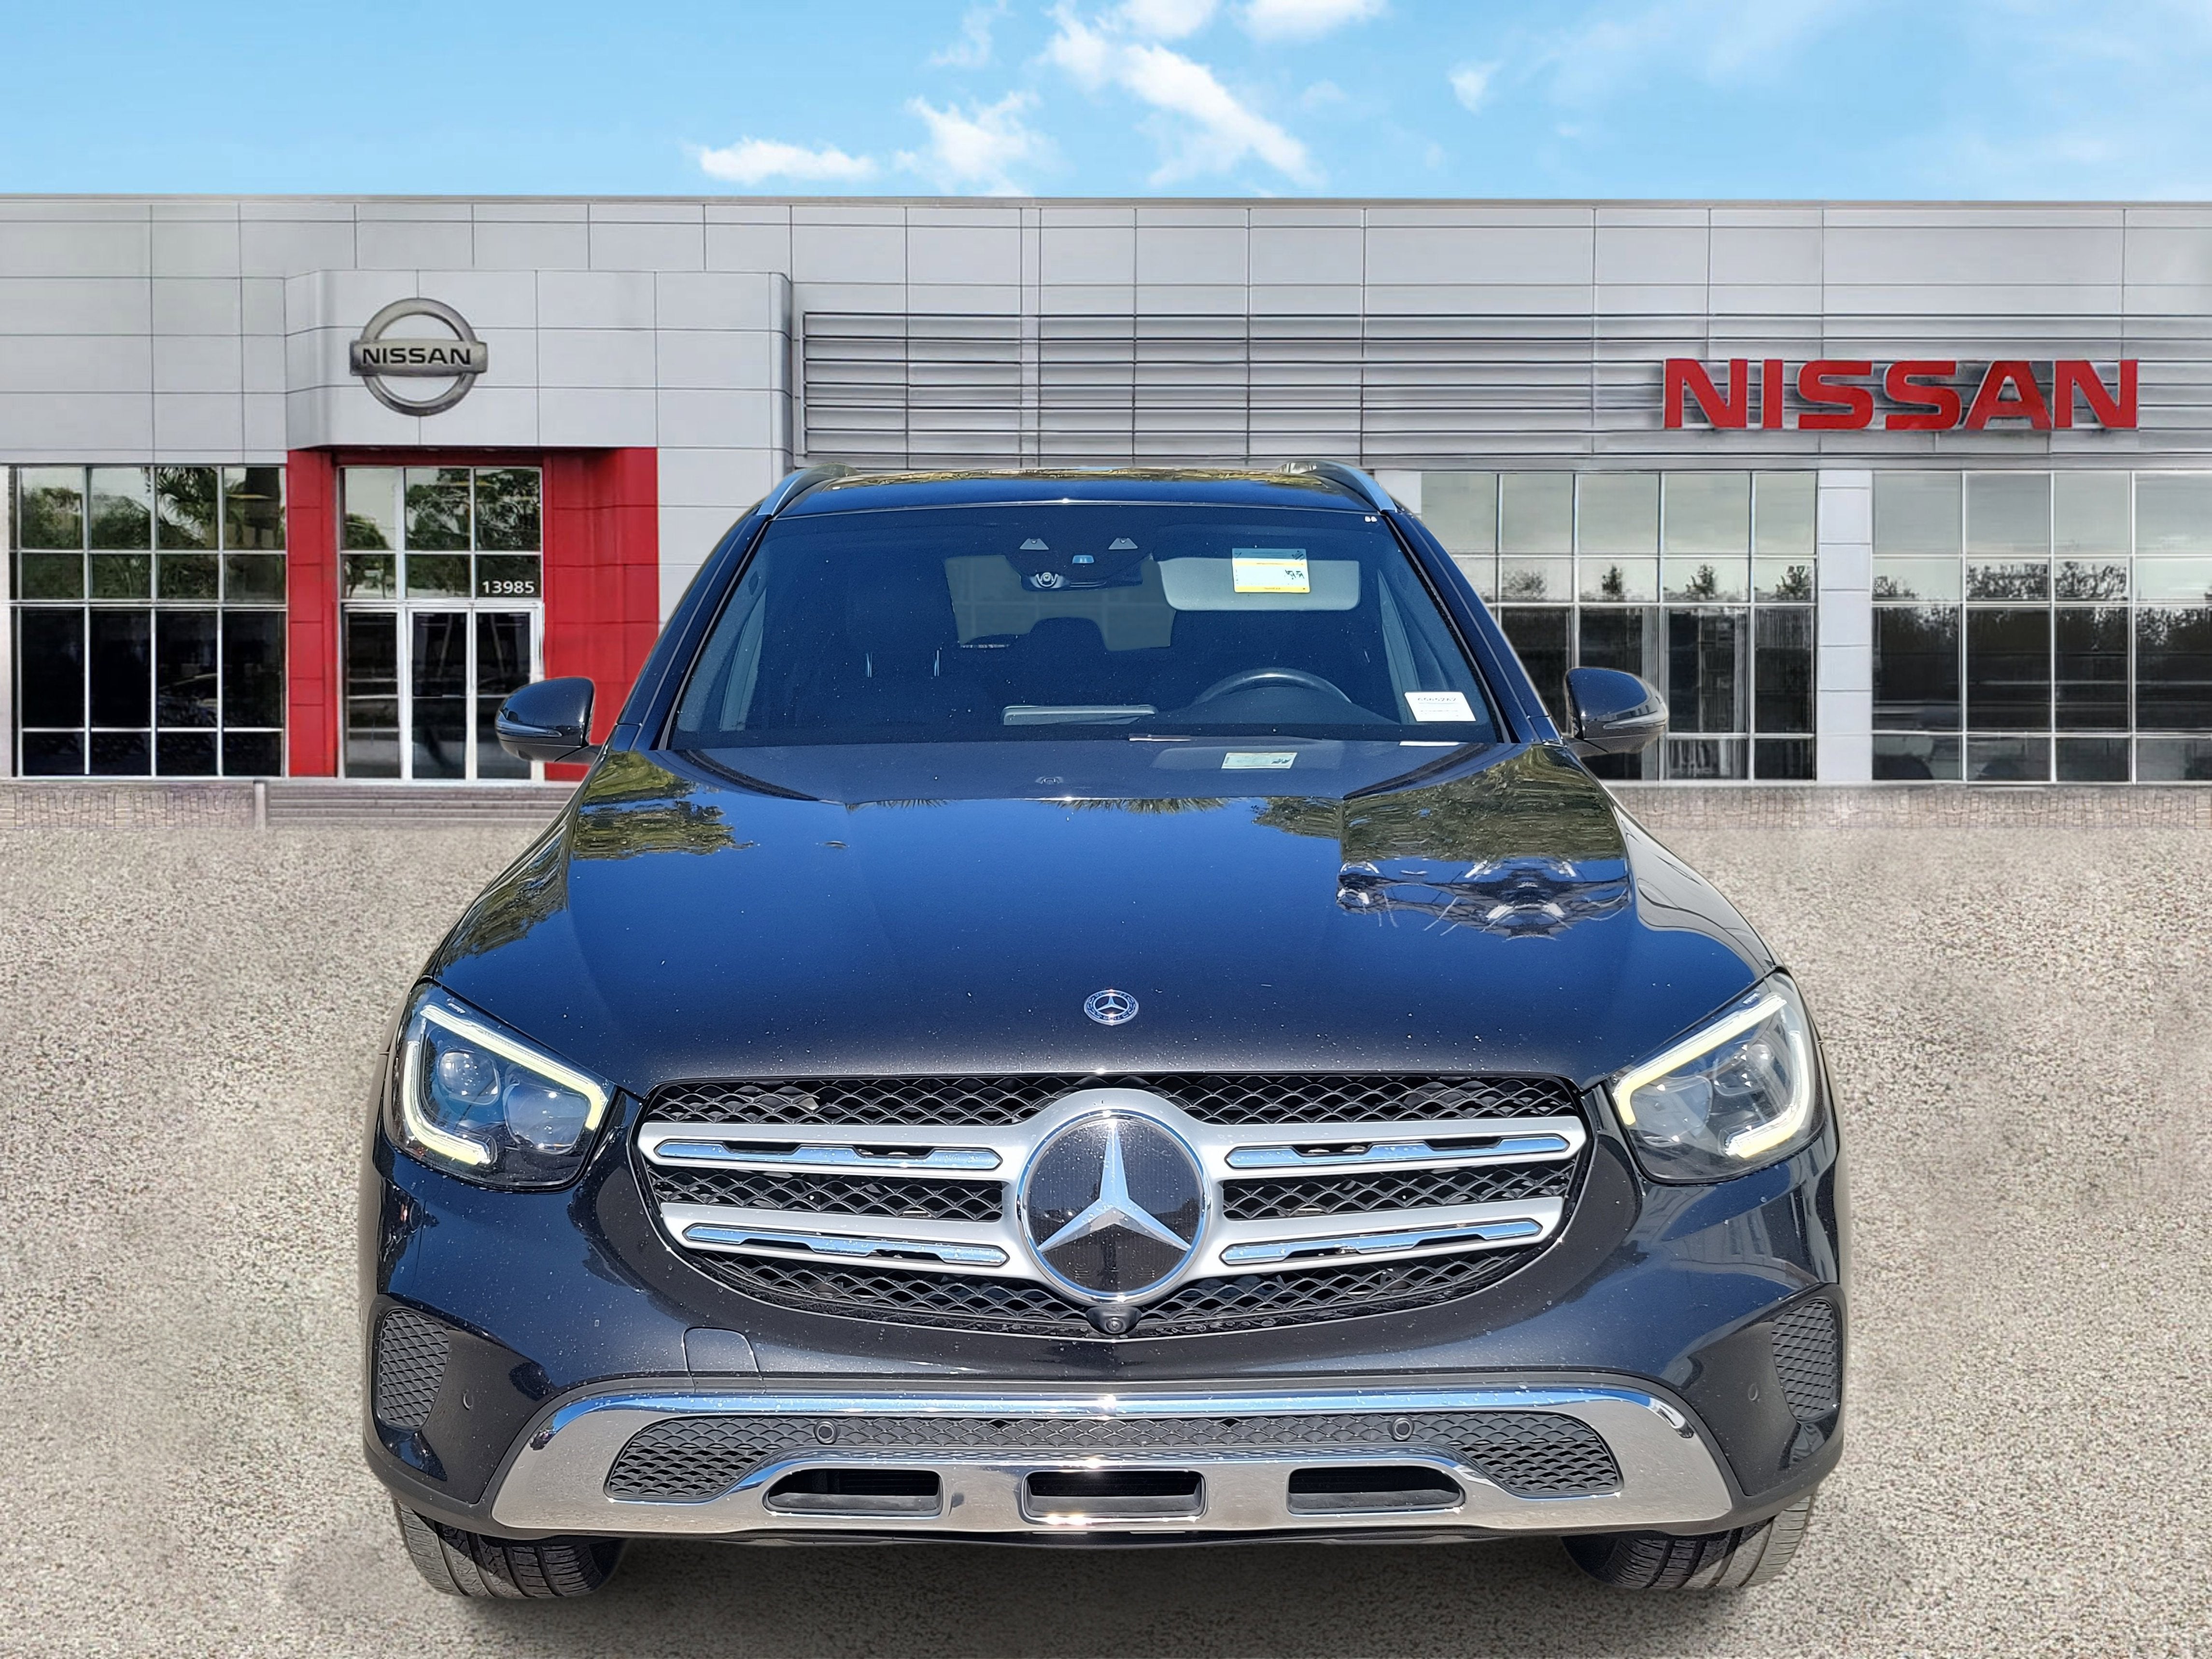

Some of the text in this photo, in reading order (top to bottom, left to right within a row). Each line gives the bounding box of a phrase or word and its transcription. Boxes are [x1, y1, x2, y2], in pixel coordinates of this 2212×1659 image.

[363, 348, 471, 365] NISSAN
[1663, 358, 2139, 430] NISSAN
[482, 580, 535, 594] 13985
